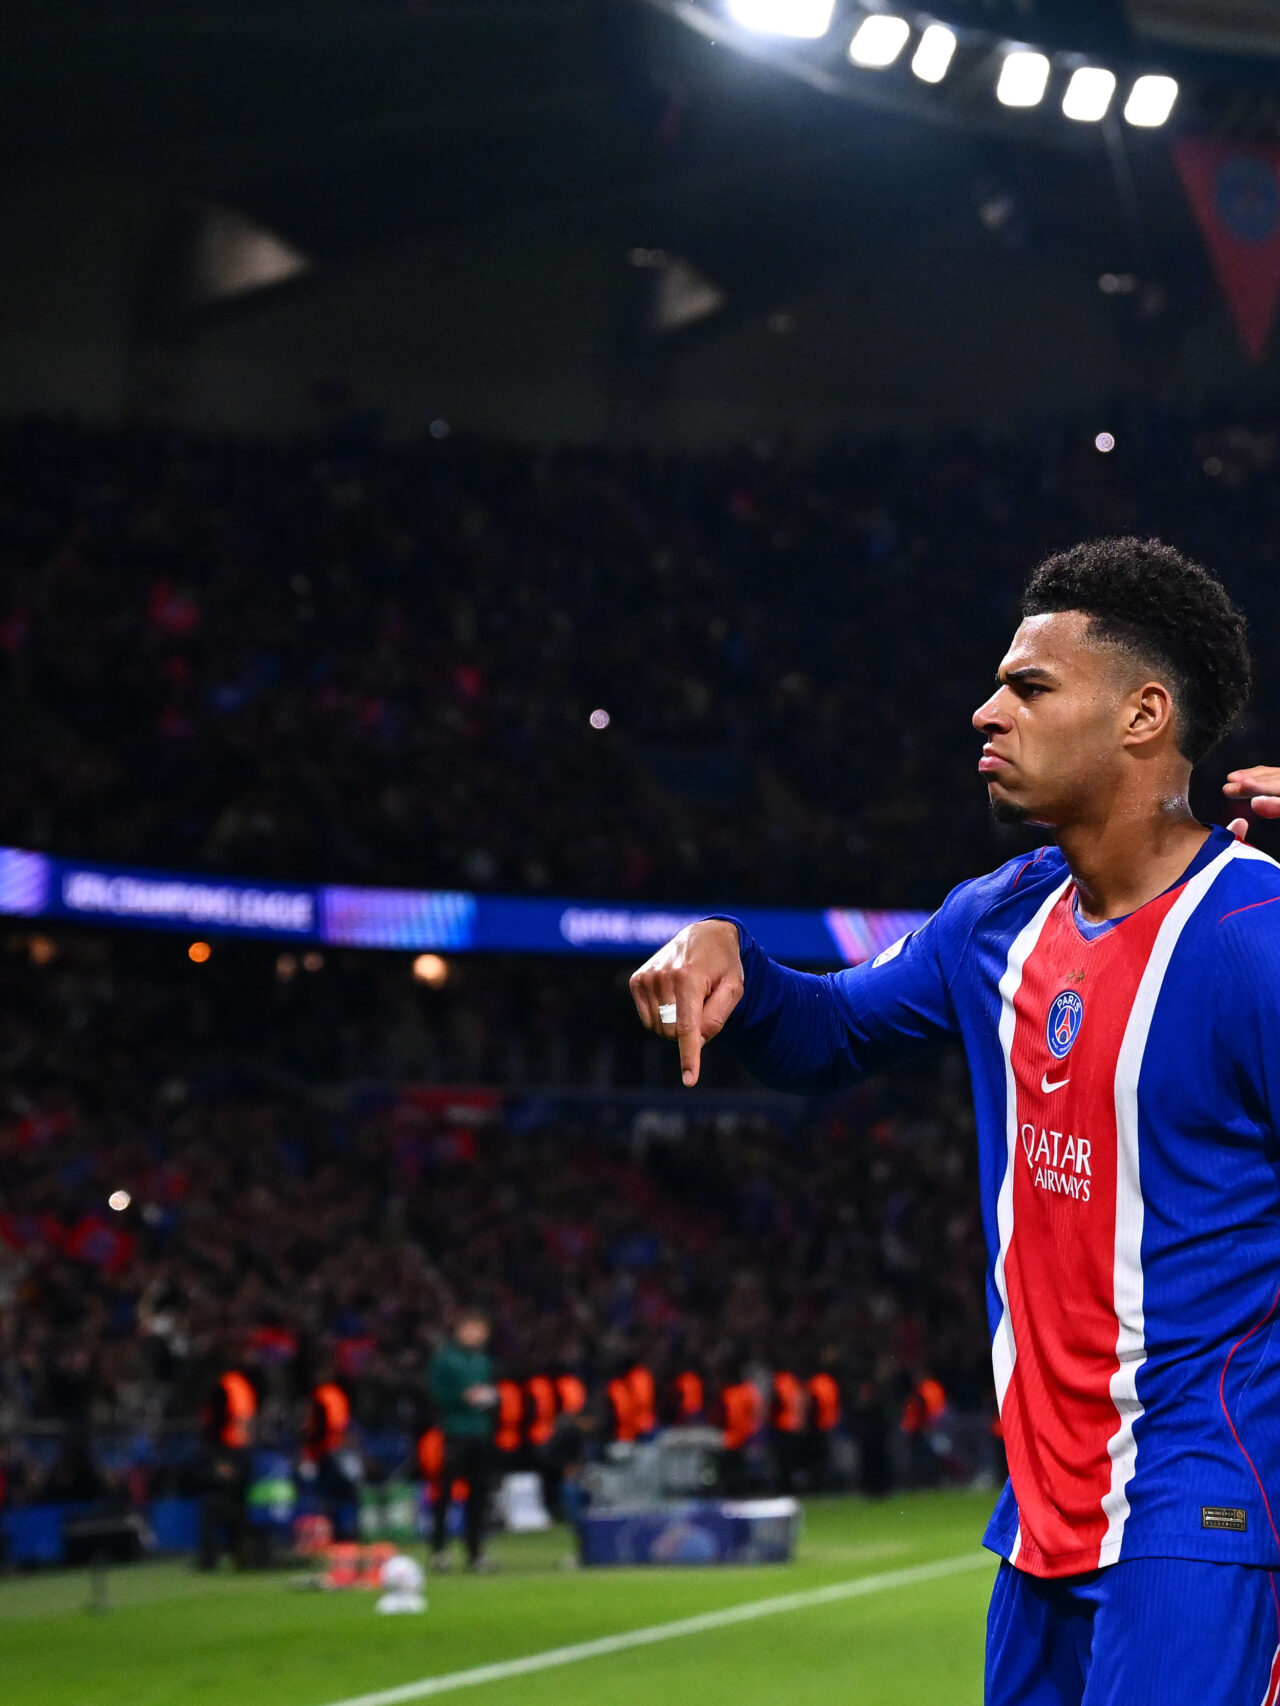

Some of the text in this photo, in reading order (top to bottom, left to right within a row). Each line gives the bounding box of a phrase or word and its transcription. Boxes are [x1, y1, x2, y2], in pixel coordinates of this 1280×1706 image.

[1057, 995, 1080, 1013] PARIS
[1021, 1123, 1092, 1177] QATAR
[1034, 1166, 1091, 1202] AIRWAYS
